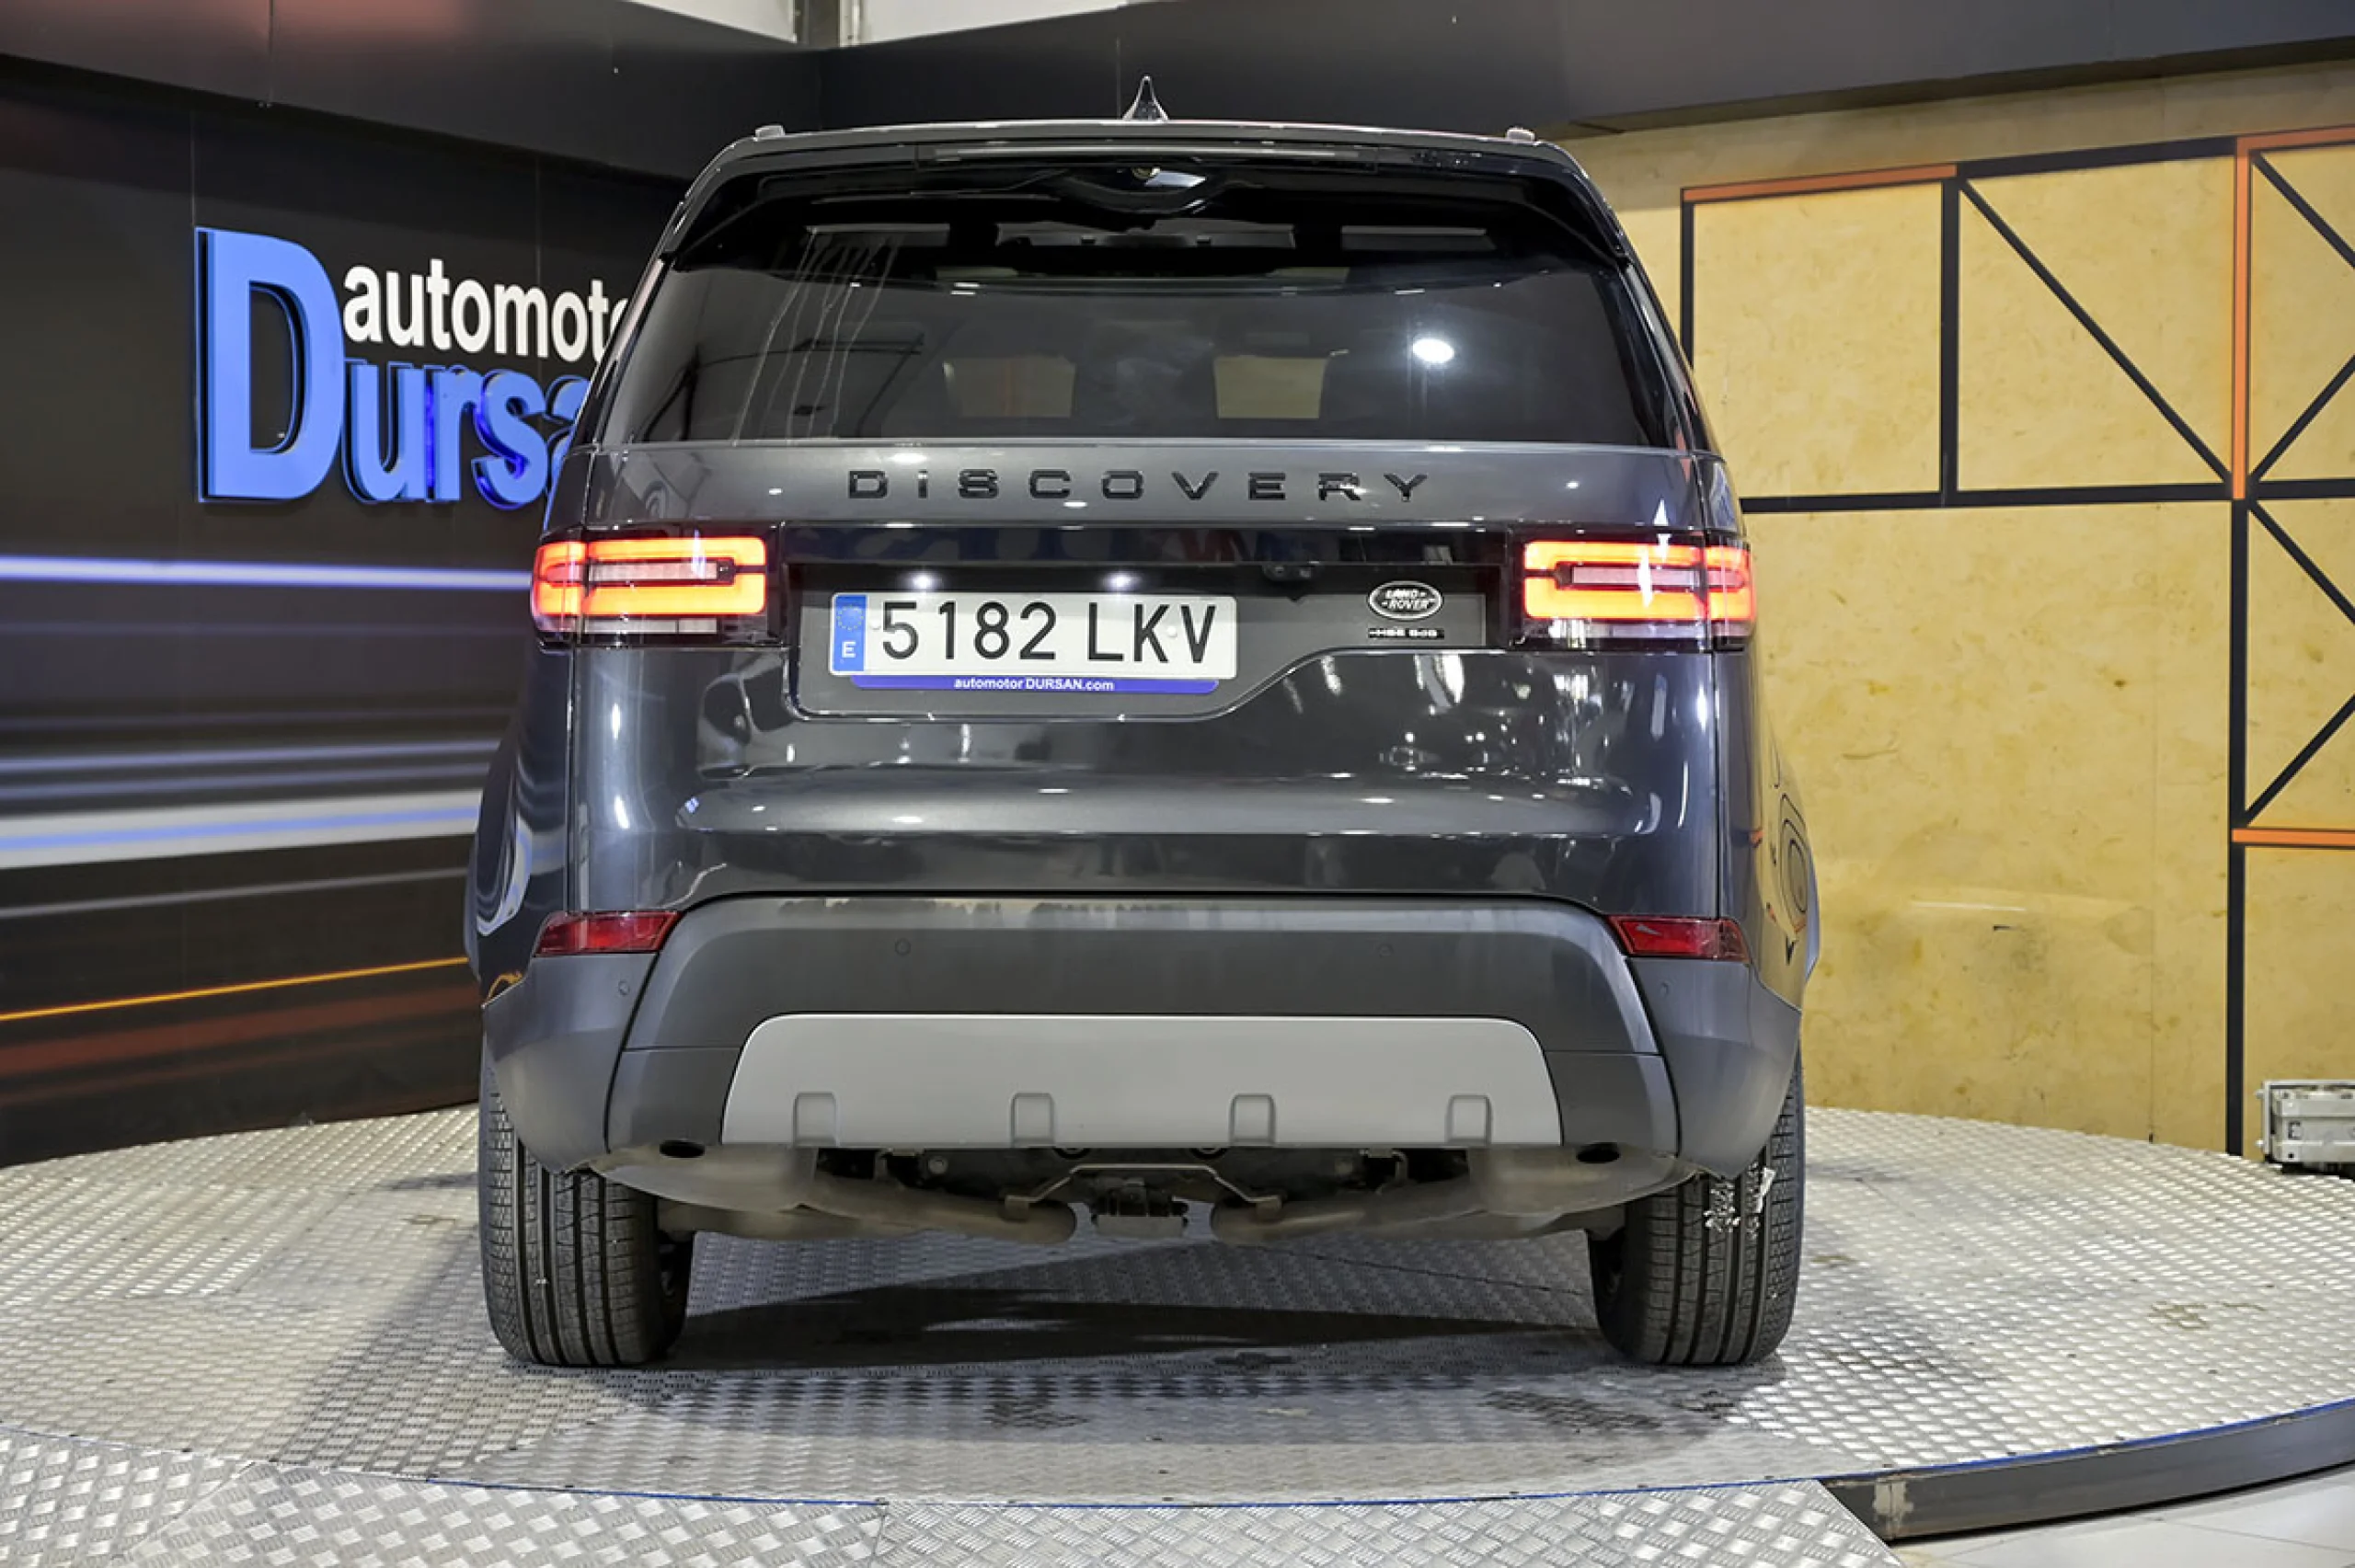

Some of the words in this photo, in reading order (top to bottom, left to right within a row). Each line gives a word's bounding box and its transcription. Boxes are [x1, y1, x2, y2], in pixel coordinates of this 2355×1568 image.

[882, 600, 1057, 661] 5182
[1087, 601, 1217, 664] LKV
[841, 641, 856, 658] E
[953, 677, 1024, 690] automotor
[1026, 677, 1115, 692] DURSAN.com
